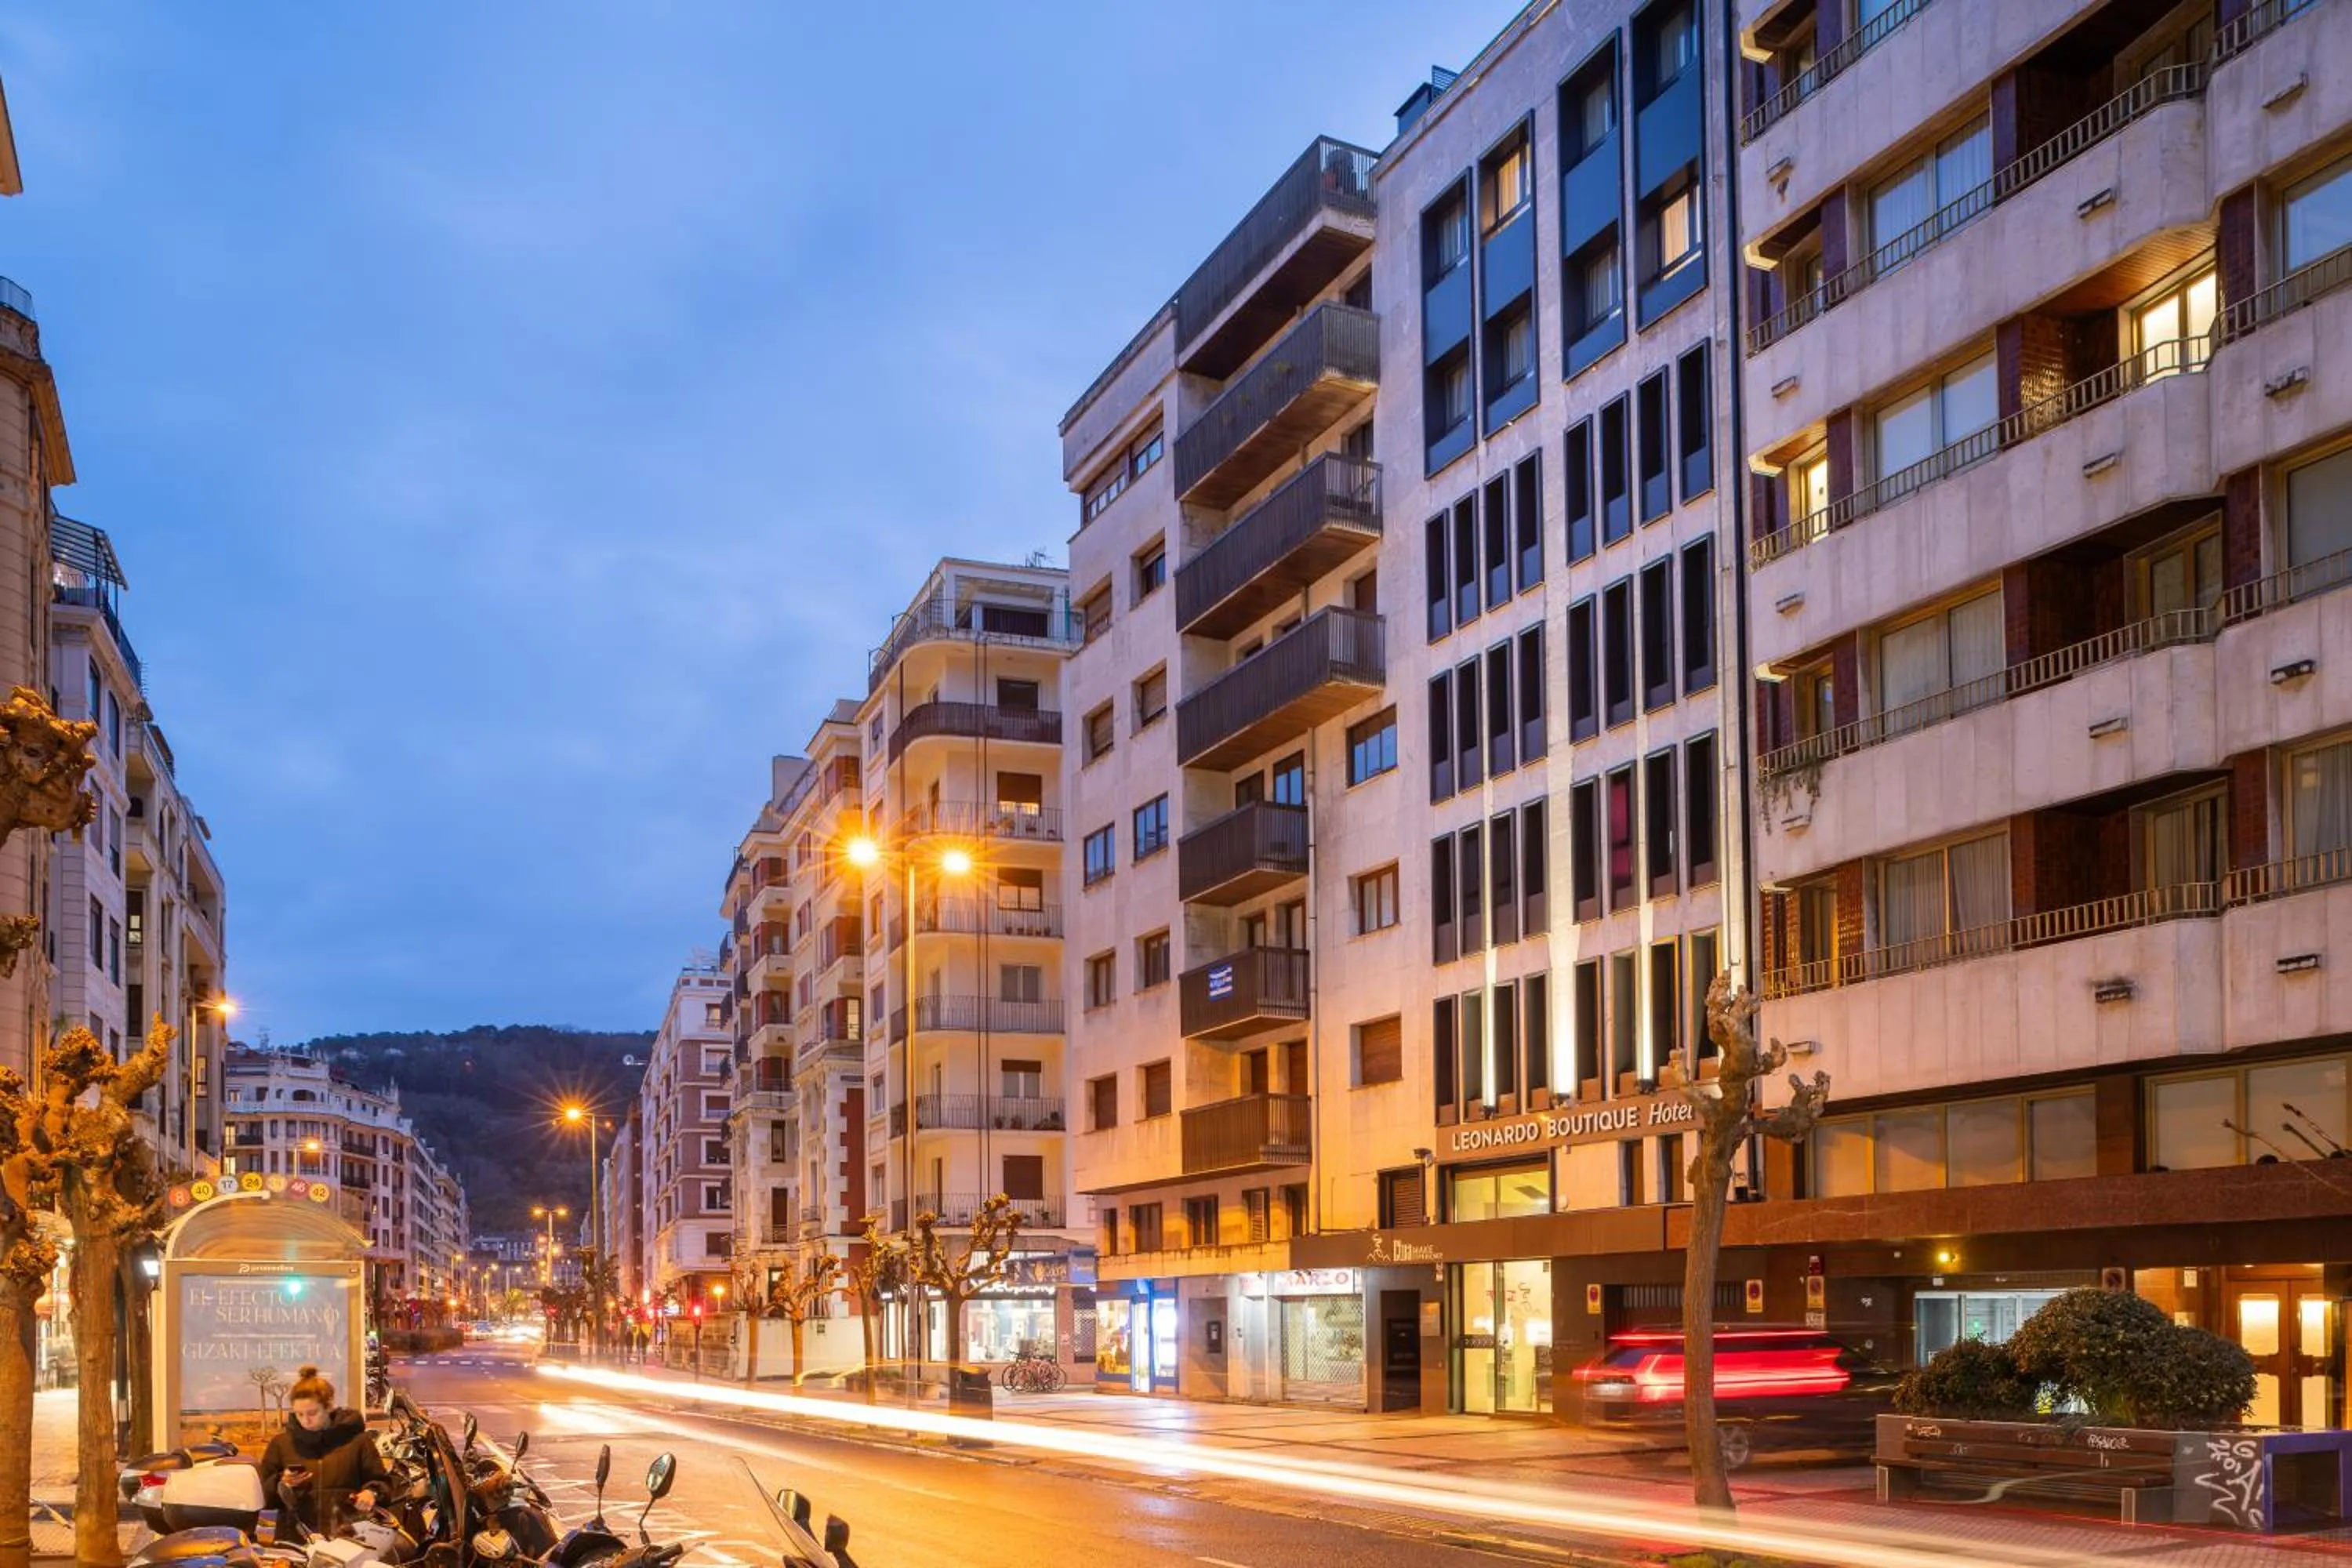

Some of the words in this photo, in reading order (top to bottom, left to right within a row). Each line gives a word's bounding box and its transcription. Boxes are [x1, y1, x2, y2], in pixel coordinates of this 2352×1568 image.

[1452, 1122, 1539, 1151] LEONARDO
[1548, 1106, 1639, 1137] BOUTIQUE
[220, 1180, 234, 1189] 17
[196, 1186, 209, 1196] 40
[313, 1187, 325, 1196] 42
[177, 1192, 186, 1204] 8
[219, 1290, 297, 1306] EFECTO
[216, 1306, 250, 1323] SER
[255, 1308, 339, 1324] HUMANO
